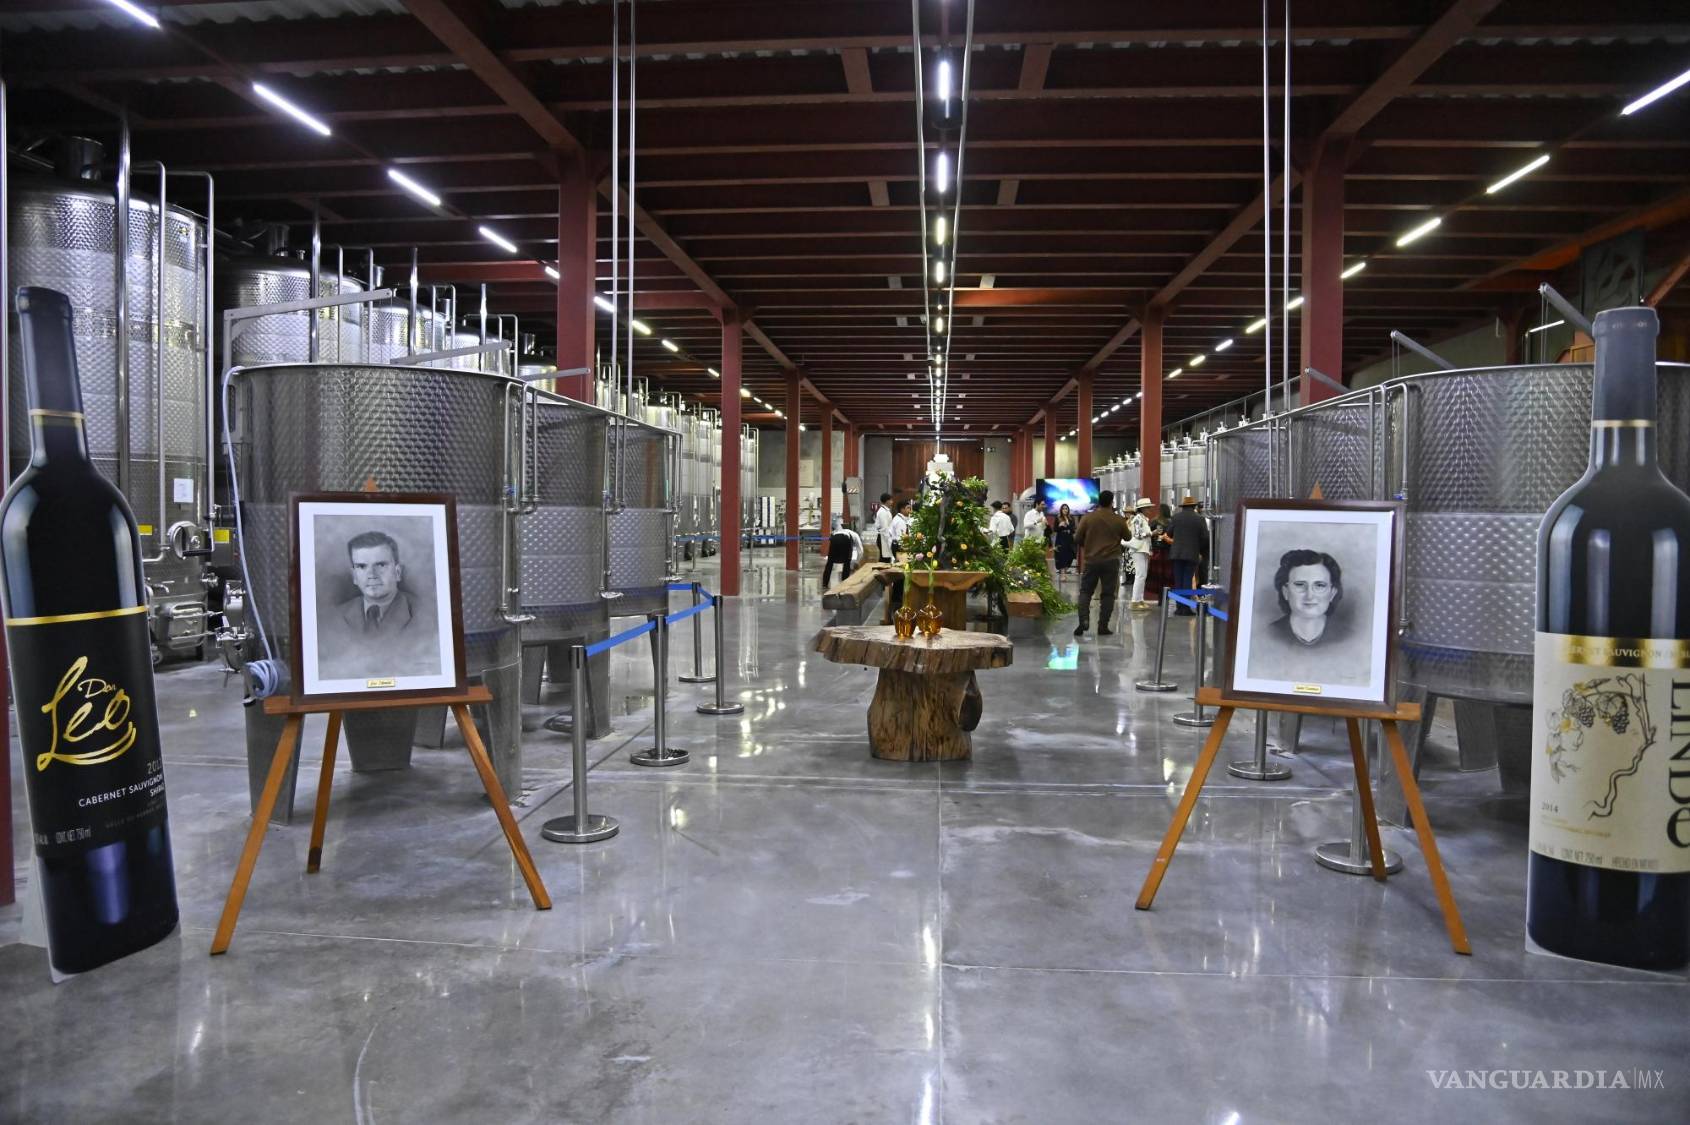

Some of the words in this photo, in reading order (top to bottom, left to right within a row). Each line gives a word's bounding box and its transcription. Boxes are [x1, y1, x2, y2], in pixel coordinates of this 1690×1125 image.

[77, 678, 116, 699] Don
[37, 655, 137, 772] Leo
[78, 787, 127, 808] CABERNET
[128, 773, 163, 794] SAUVIGNON
